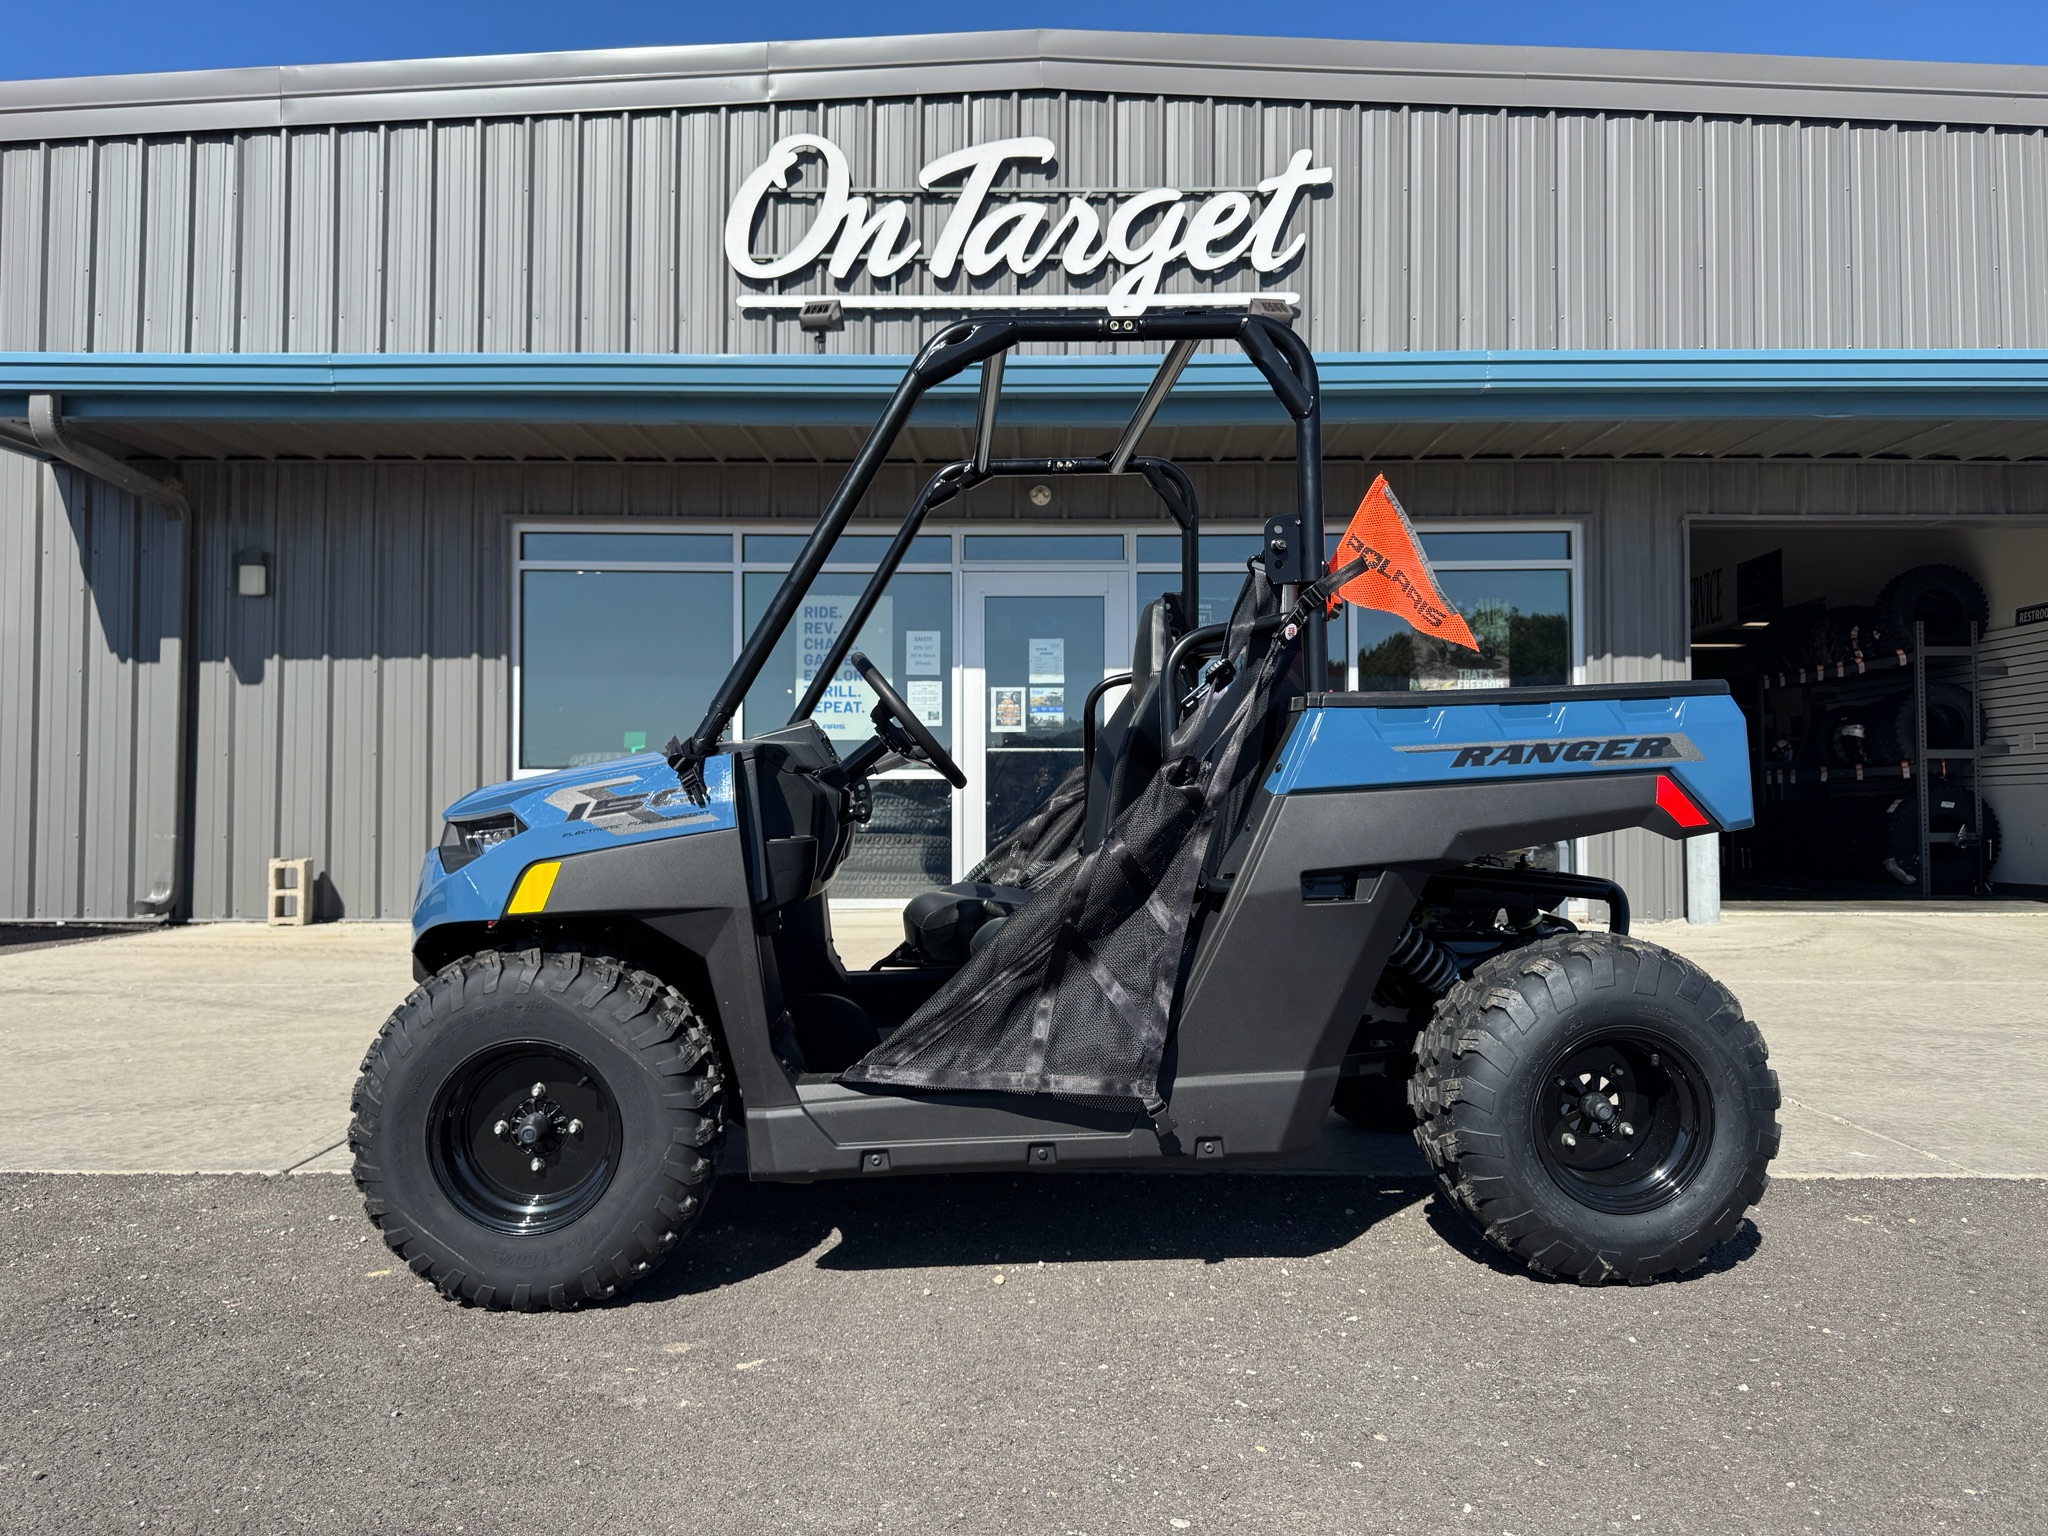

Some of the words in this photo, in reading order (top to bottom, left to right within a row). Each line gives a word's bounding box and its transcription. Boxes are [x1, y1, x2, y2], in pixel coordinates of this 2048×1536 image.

[1346, 532, 1447, 628] POLARIS
[804, 606, 842, 619] RIDE.
[804, 622, 837, 635] REV.
[1457, 669, 1494, 680] THAT'S
[814, 701, 865, 713] EPEAT.
[1449, 737, 1682, 769] RANGER
[562, 823, 623, 838] ELECTRONIC
[628, 819, 652, 827] FUEL
[659, 809, 710, 822] INJECTION
